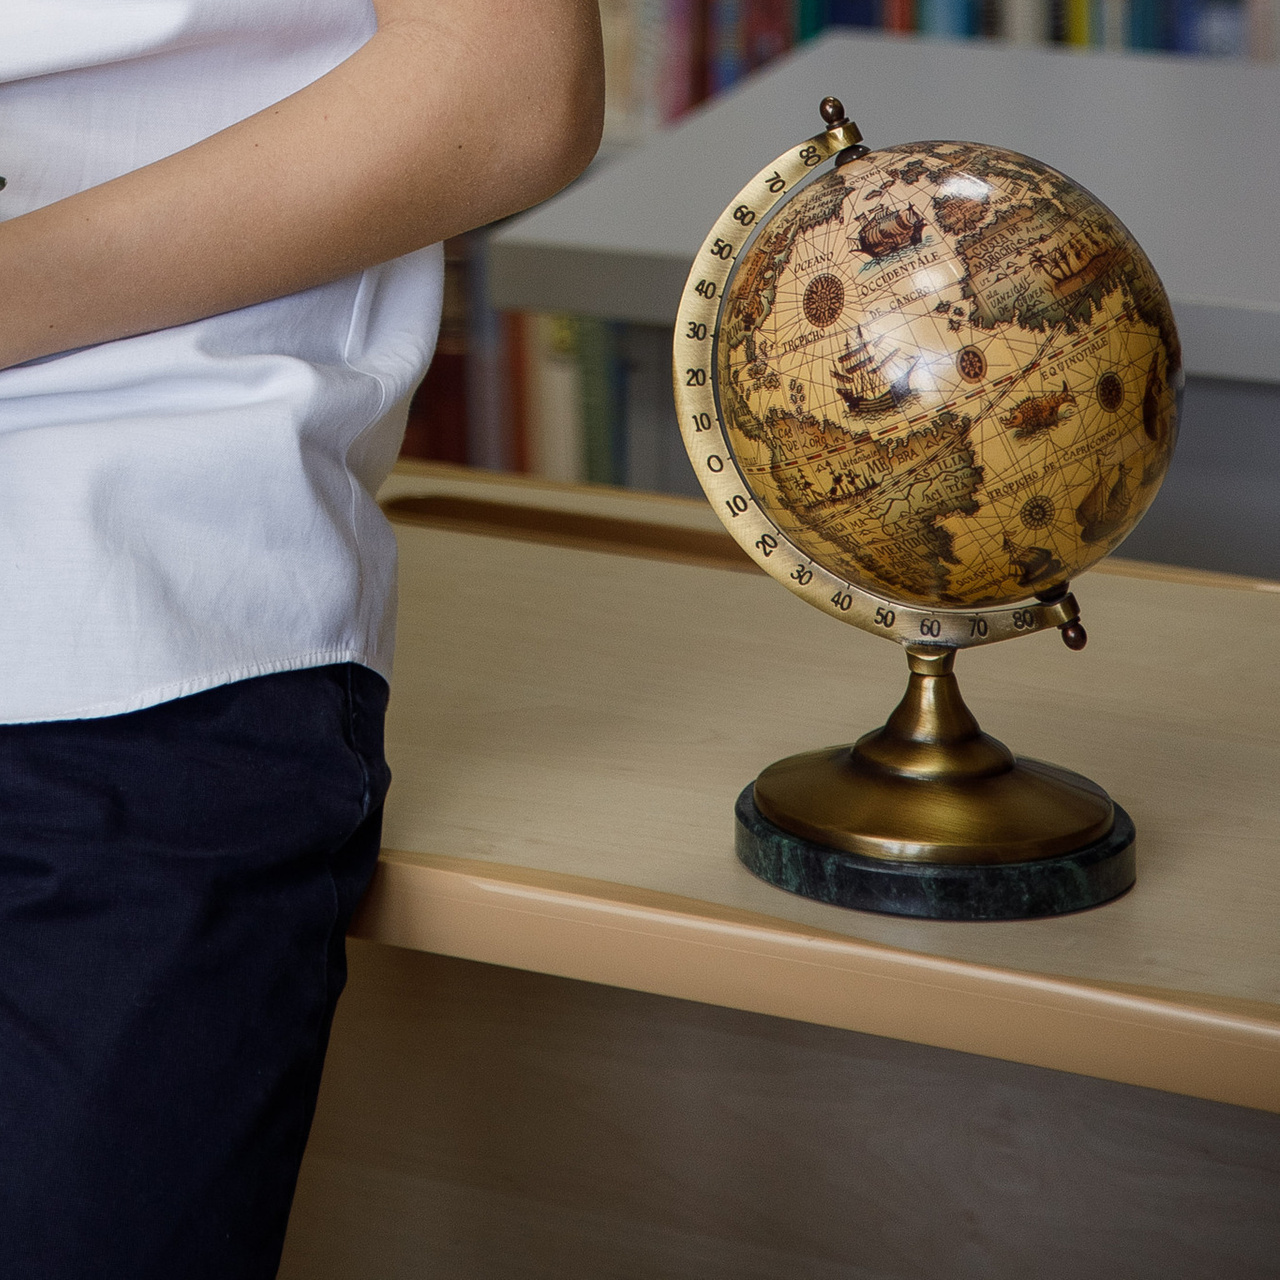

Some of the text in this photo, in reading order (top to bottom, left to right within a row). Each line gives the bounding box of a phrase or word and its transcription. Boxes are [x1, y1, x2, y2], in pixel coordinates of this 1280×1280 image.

[799, 145, 822, 167] 80
[764, 171, 786, 194] 70
[733, 205, 756, 227] 60
[710, 238, 733, 260] 50
[971, 224, 1023, 256] COSTA DE
[794, 251, 834, 274] OCEANO
[859, 251, 941, 297] OCCIDENTALE
[694, 279, 717, 300] 40
[869, 306, 883, 320] DE
[998, 305, 1011, 317] DE
[686, 322, 707, 341] 30
[1041, 336, 1109, 381] EQUINOTIALE
[686, 368, 706, 387] 20
[691, 413, 712, 433] 10
[706, 455, 724, 473] 0
[987, 427, 1118, 499] TROPICHO DE CAPRICORNO
[725, 495, 749, 517] 10
[755, 533, 778, 557] 20
[789, 564, 813, 586] 30
[830, 591, 853, 612] 40
[873, 608, 896, 628] 50
[919, 618, 941, 637] 60
[968, 618, 988, 637] 70
[1012, 609, 1034, 630] 80
